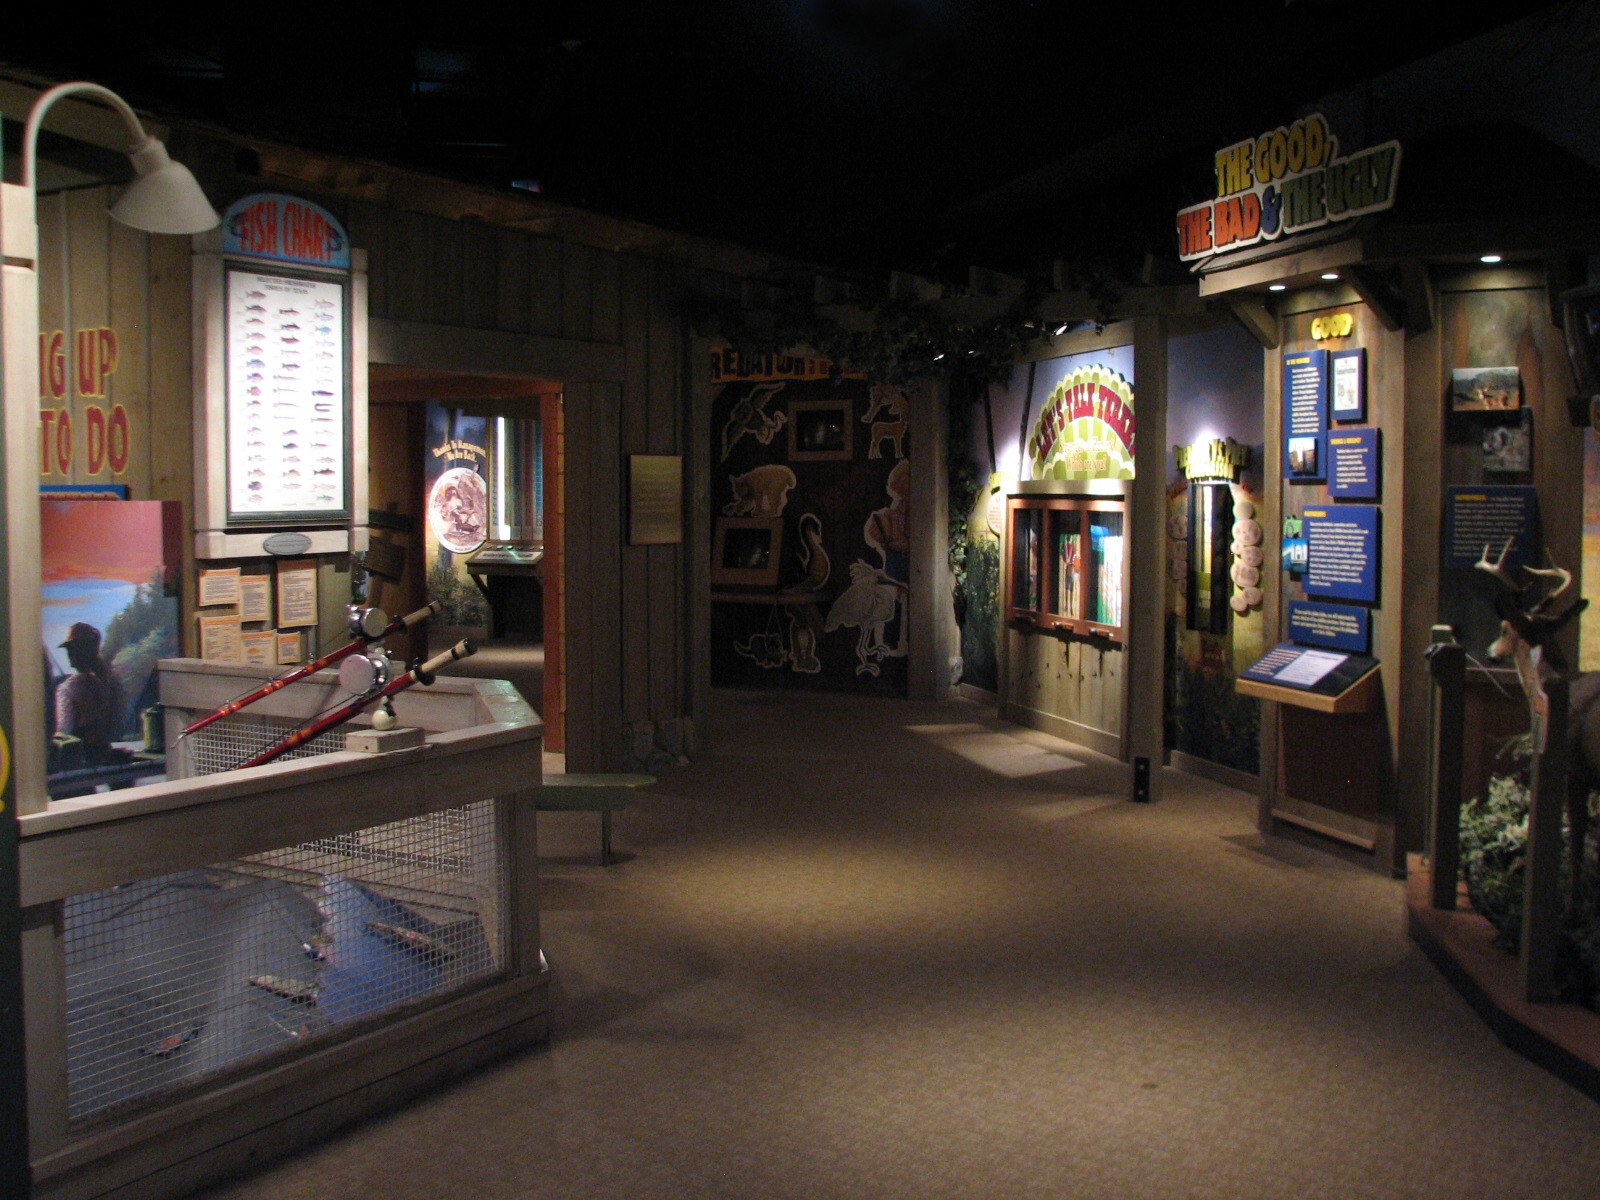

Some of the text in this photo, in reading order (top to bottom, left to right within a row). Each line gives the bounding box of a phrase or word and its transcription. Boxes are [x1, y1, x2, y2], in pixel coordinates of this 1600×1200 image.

[1215, 117, 1334, 197] THE GOOD,
[240, 199, 333, 261] FISH CHART
[1177, 146, 1396, 257] THE BAD & THE UGLY
[1310, 313, 1353, 340] GOOD
[78, 327, 119, 398] UP
[40, 405, 130, 476] TO DO
